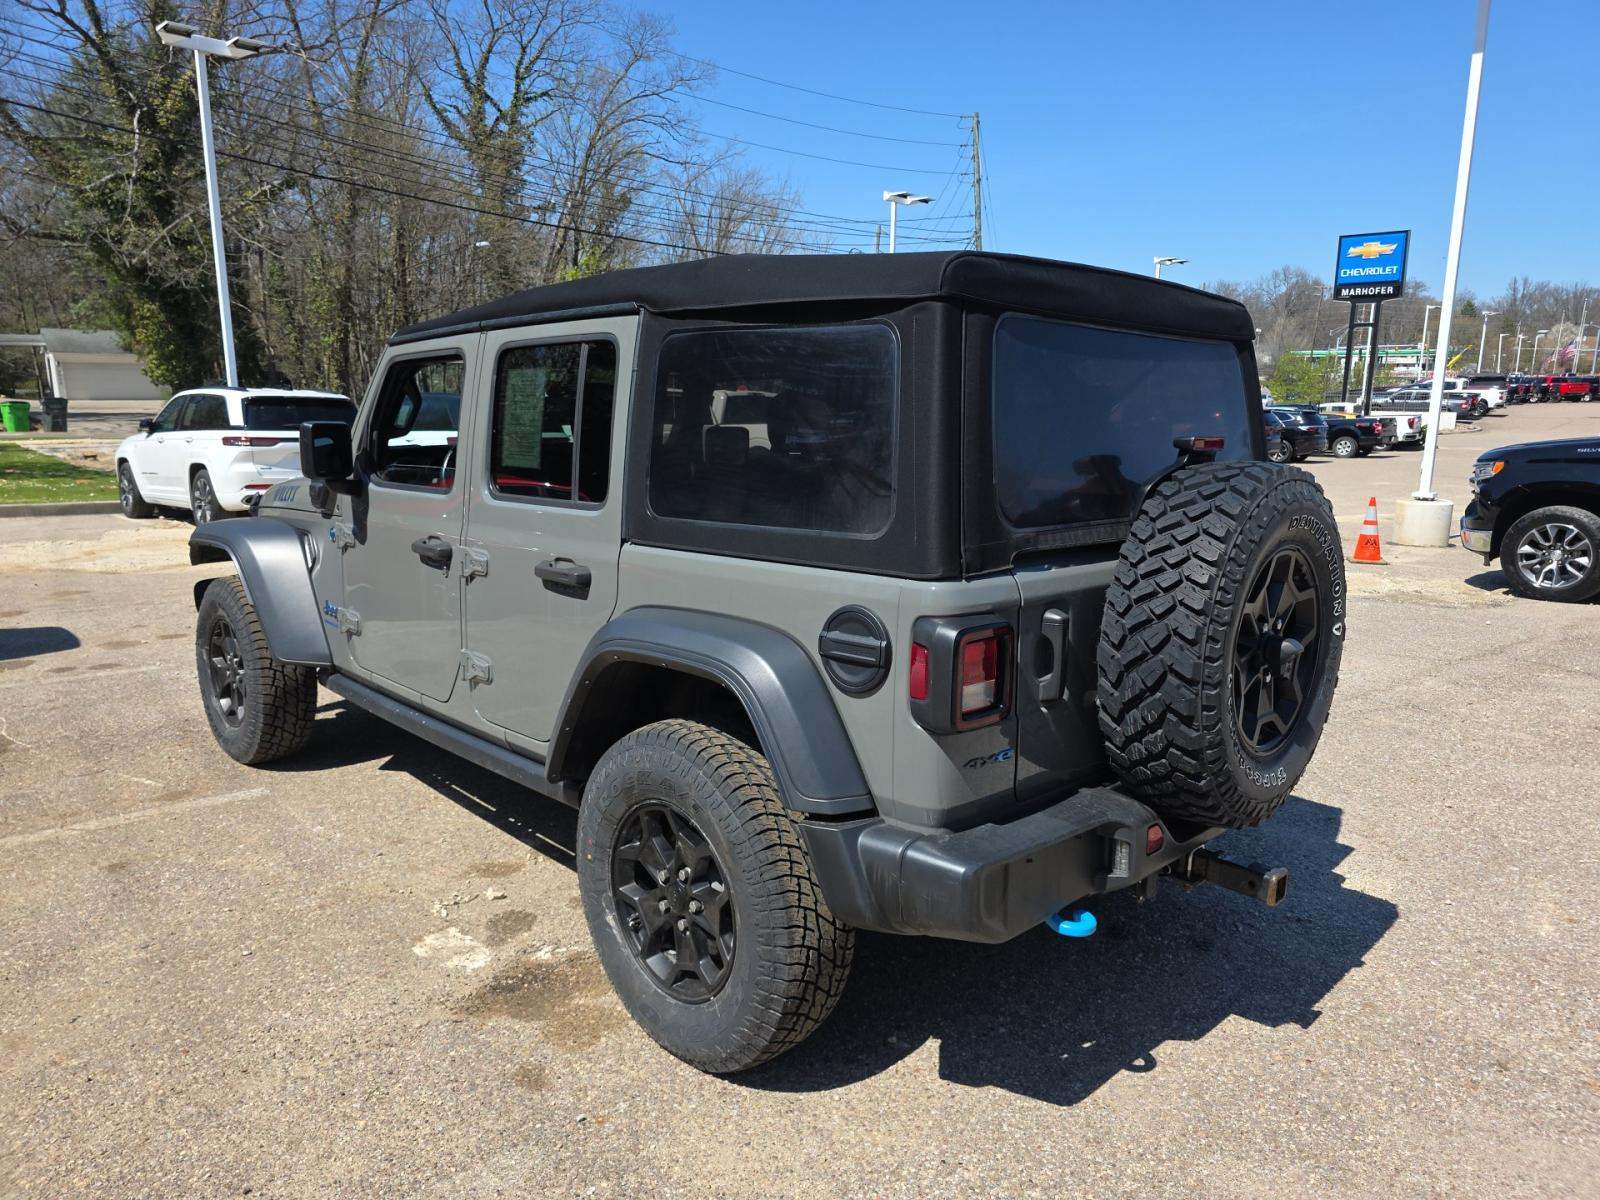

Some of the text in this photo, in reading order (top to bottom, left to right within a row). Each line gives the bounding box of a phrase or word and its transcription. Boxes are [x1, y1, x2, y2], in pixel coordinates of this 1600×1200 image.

[1340, 265, 1398, 277] CHEVROLET
[1341, 286, 1394, 297] MARHOFER
[1288, 514, 1343, 617] DESTINATION
